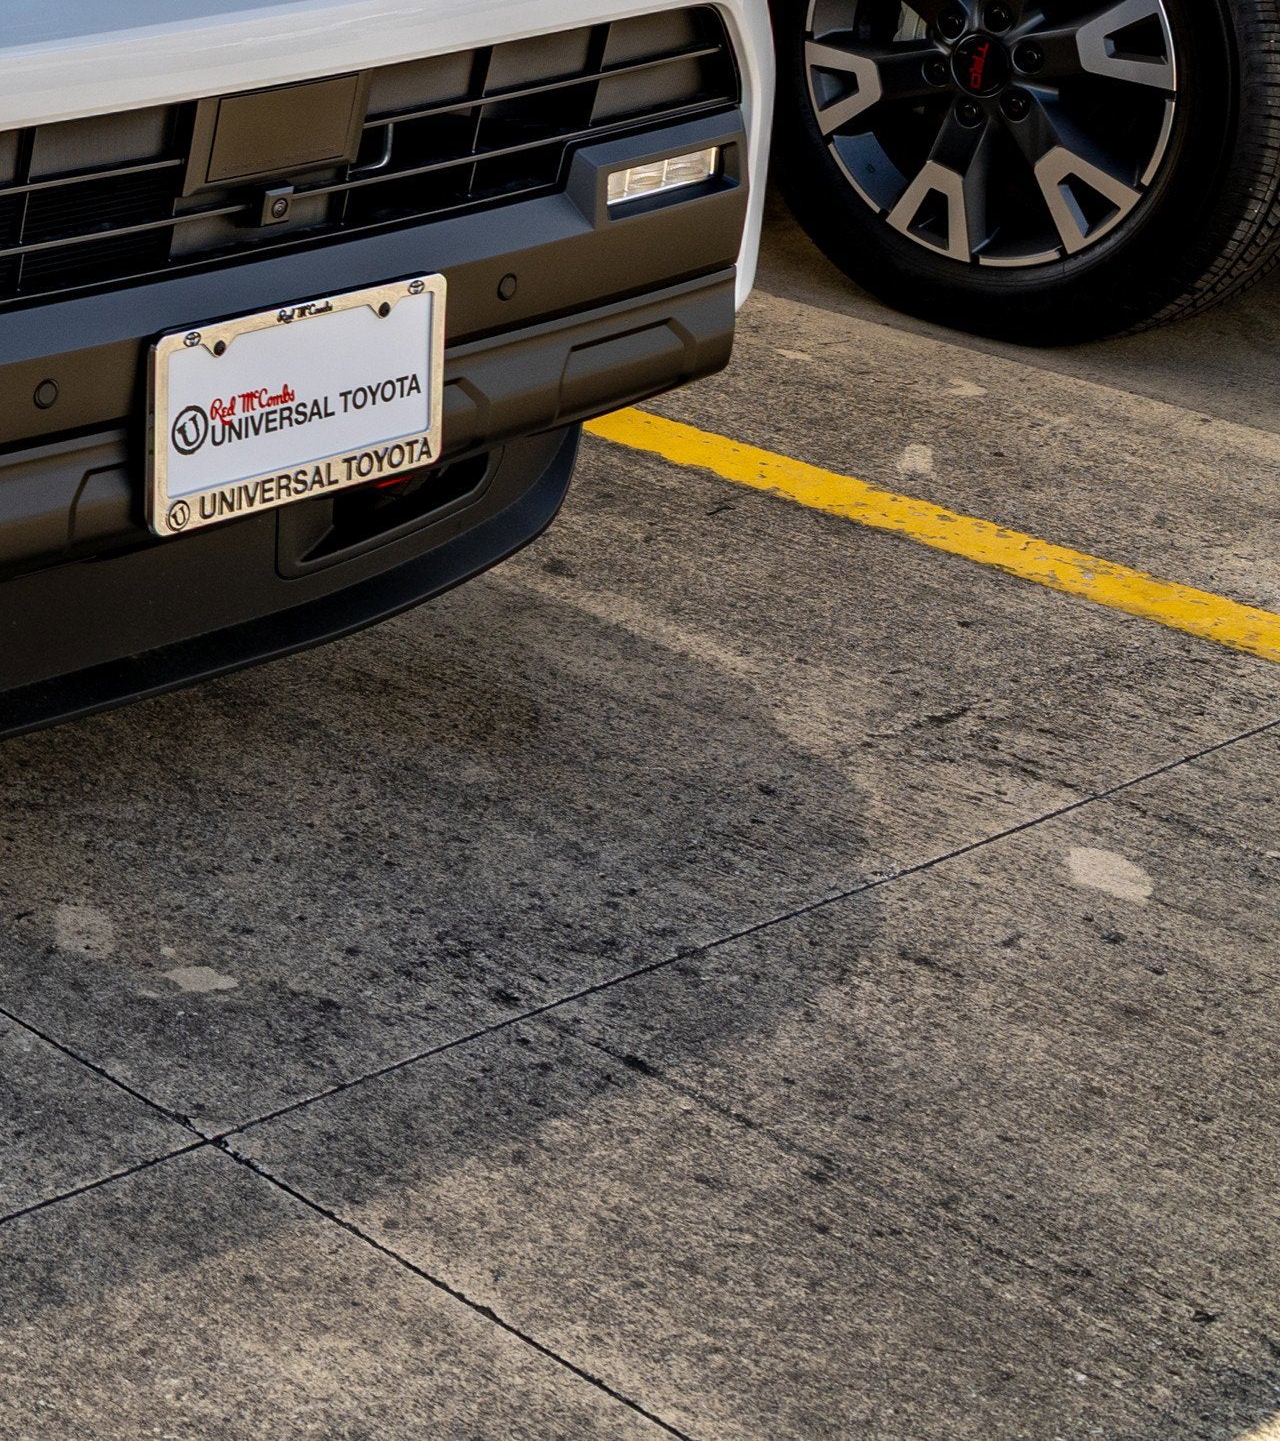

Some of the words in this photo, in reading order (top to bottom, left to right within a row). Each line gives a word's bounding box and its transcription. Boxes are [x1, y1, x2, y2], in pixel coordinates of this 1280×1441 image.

[210, 395, 236, 425] Red
[237, 384, 295, 414] McCombs
[211, 396, 335, 446] UNIVERSAL
[339, 373, 422, 414] TOYOTA
[199, 462, 339, 520] UNIVERSAL
[342, 437, 433, 481] TOYOTA
